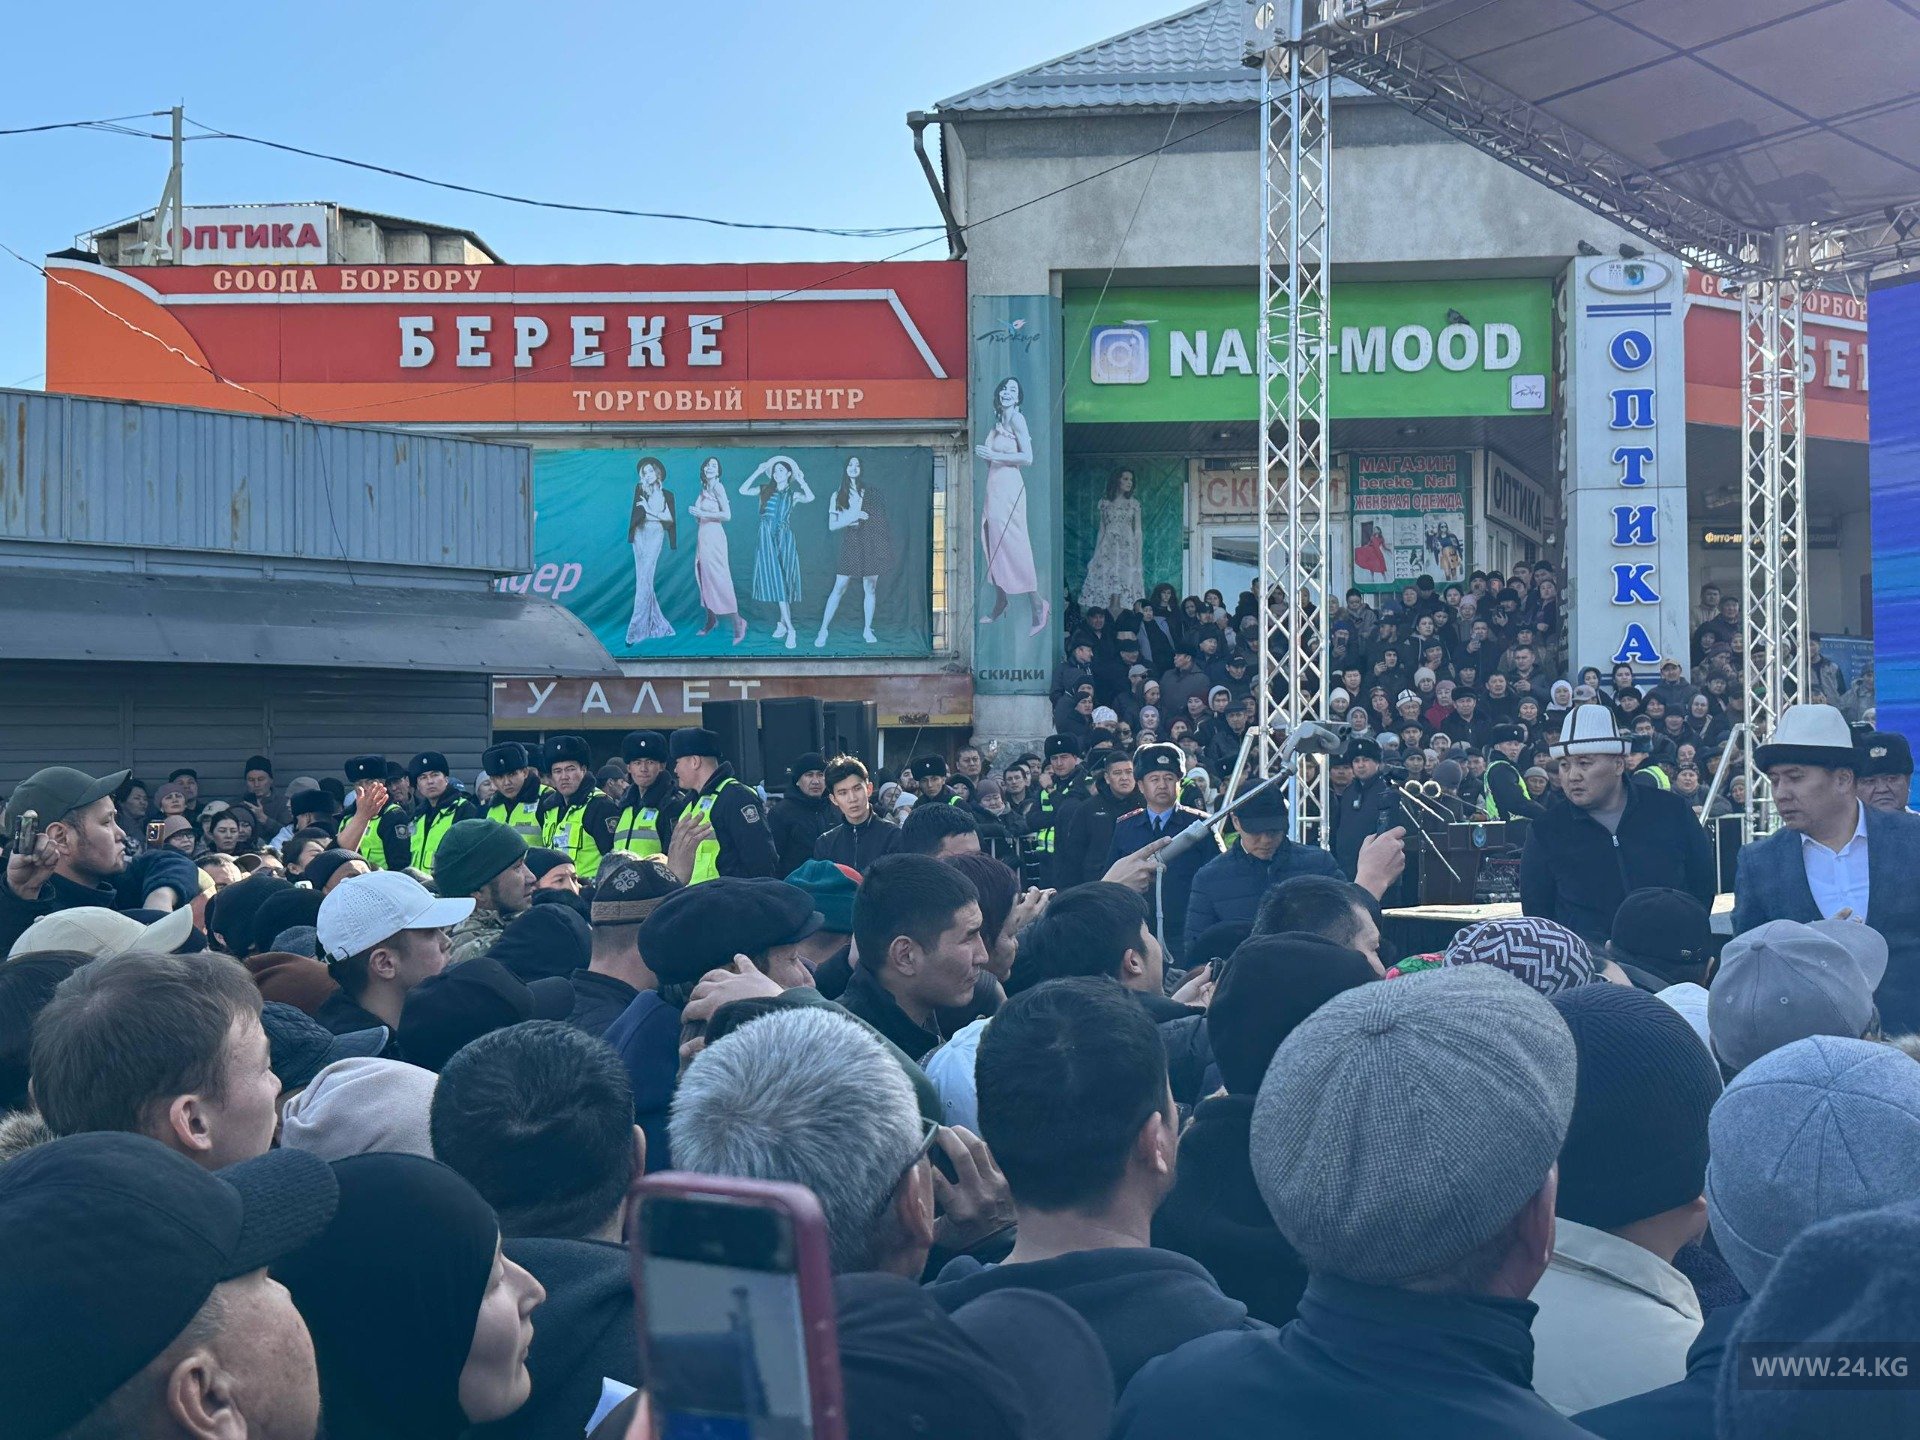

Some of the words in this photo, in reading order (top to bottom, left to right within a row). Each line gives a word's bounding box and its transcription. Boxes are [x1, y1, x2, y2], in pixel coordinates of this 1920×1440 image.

[167, 223, 322, 250] ОПТИКА
[213, 269, 318, 293] СООДА
[340, 269, 482, 292] БОРБОРУ
[398, 314, 724, 368] БЕРЕКЕ
[572, 386, 743, 411] ТОРГОВЫЙ
[765, 388, 865, 411] ЦЕНТР
[1359, 455, 1457, 473] МАГАЗИН
[1354, 493, 1411, 511] ЖЕНСКАЯ
[1412, 492, 1465, 512] ОДЕЖДА
[1493, 465, 1542, 534] ОПТИКА
[1608, 328, 1662, 665] ОПТИКА
